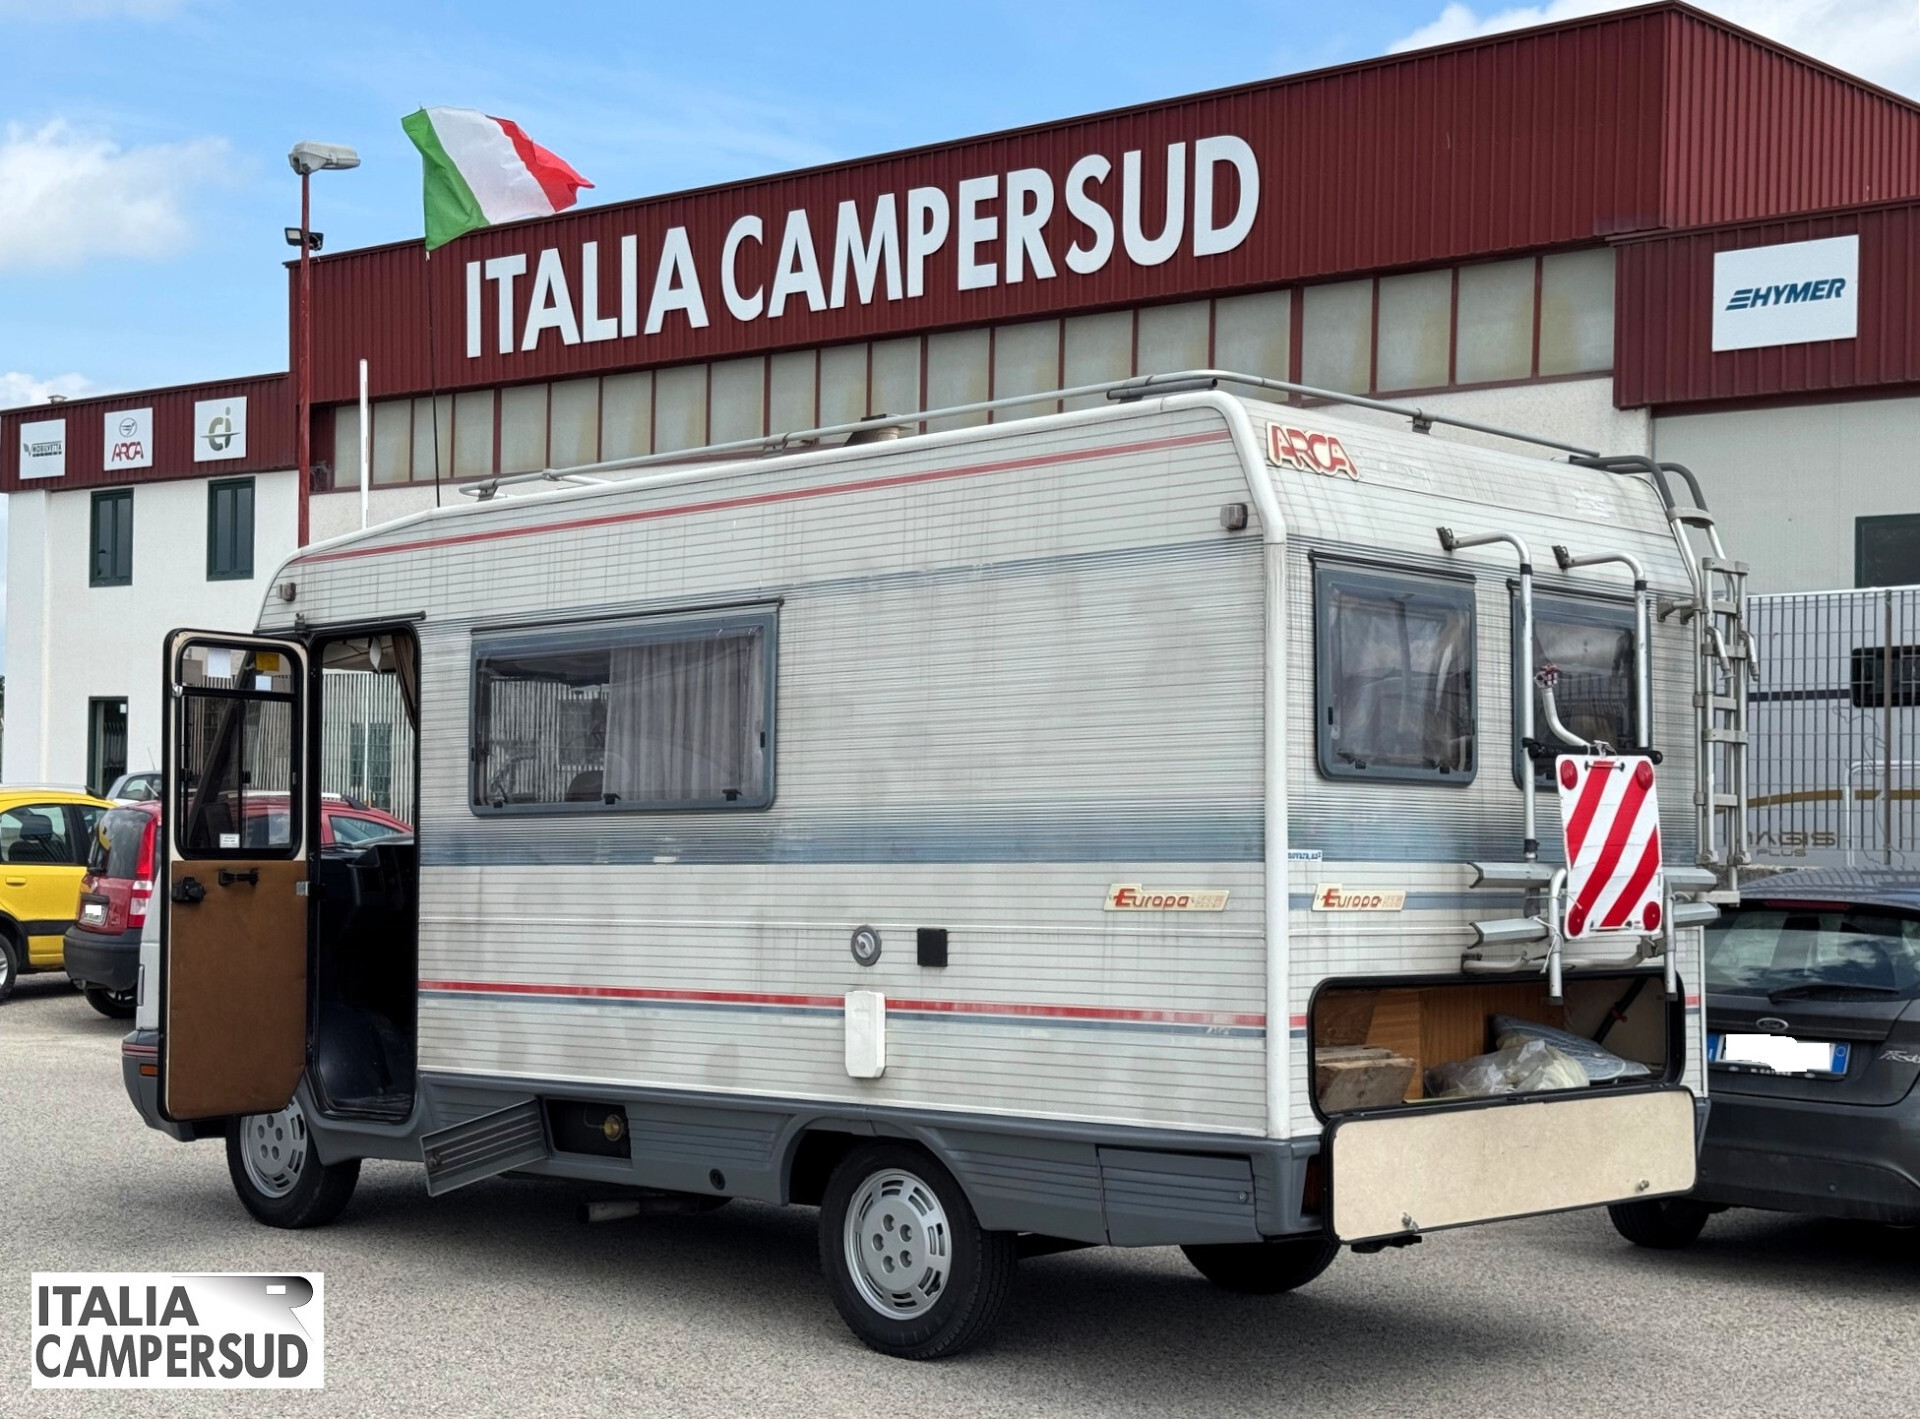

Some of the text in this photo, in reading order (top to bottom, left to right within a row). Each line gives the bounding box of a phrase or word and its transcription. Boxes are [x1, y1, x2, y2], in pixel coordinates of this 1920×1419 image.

[465, 134, 1260, 358] ITALIA CAMPERSUD
[1749, 277, 1846, 308] HYMER
[111, 440, 144, 463] ARCA
[1268, 422, 1359, 480] ARCA
[1756, 848, 1807, 857] PLUS
[1113, 887, 1190, 909] Europa
[1321, 888, 1381, 910] Europa
